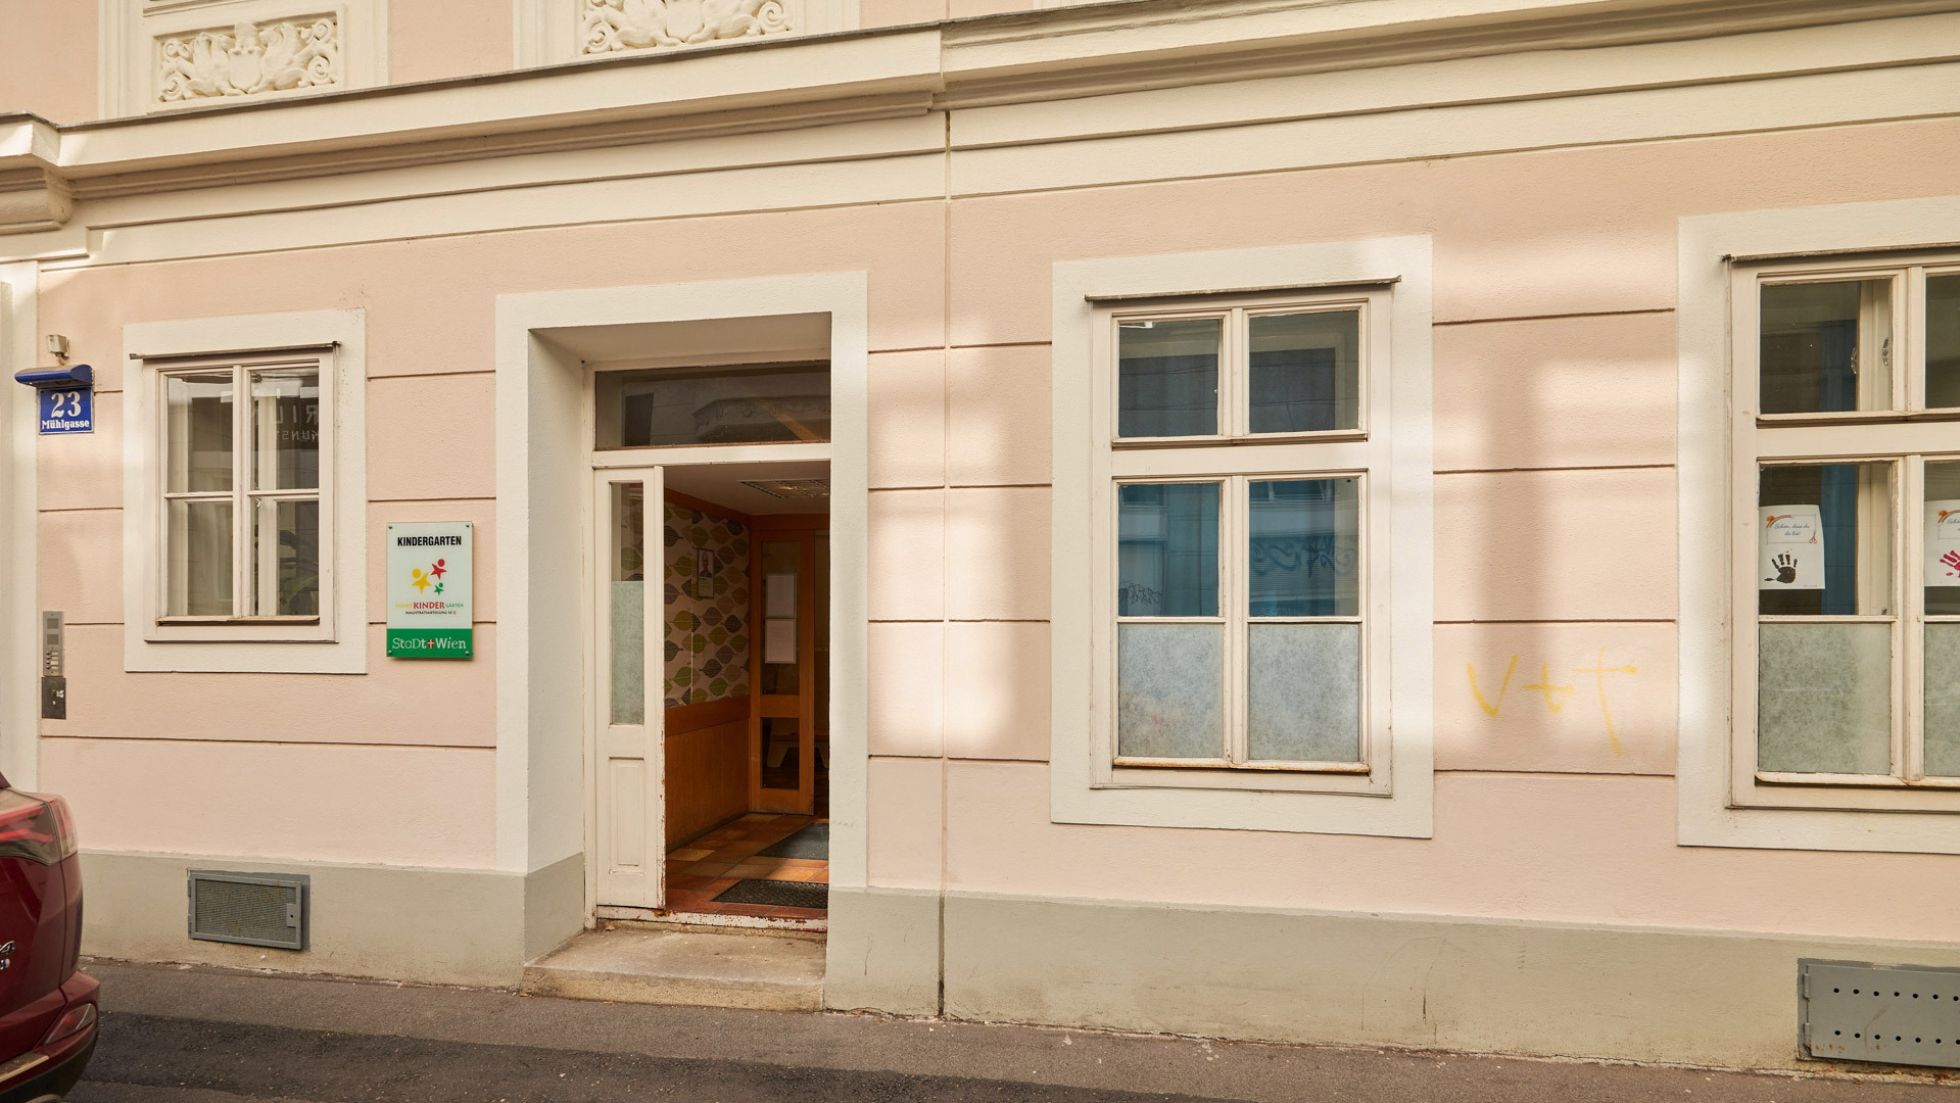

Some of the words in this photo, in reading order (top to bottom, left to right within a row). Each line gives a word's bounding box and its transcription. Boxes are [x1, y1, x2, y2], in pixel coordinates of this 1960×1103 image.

[51, 391, 81, 418] 23
[41, 419, 90, 431] Mühlgasse
[397, 536, 462, 547] KINDERGARTEN
[413, 601, 445, 609] KINDER
[435, 636, 467, 649] Wien
